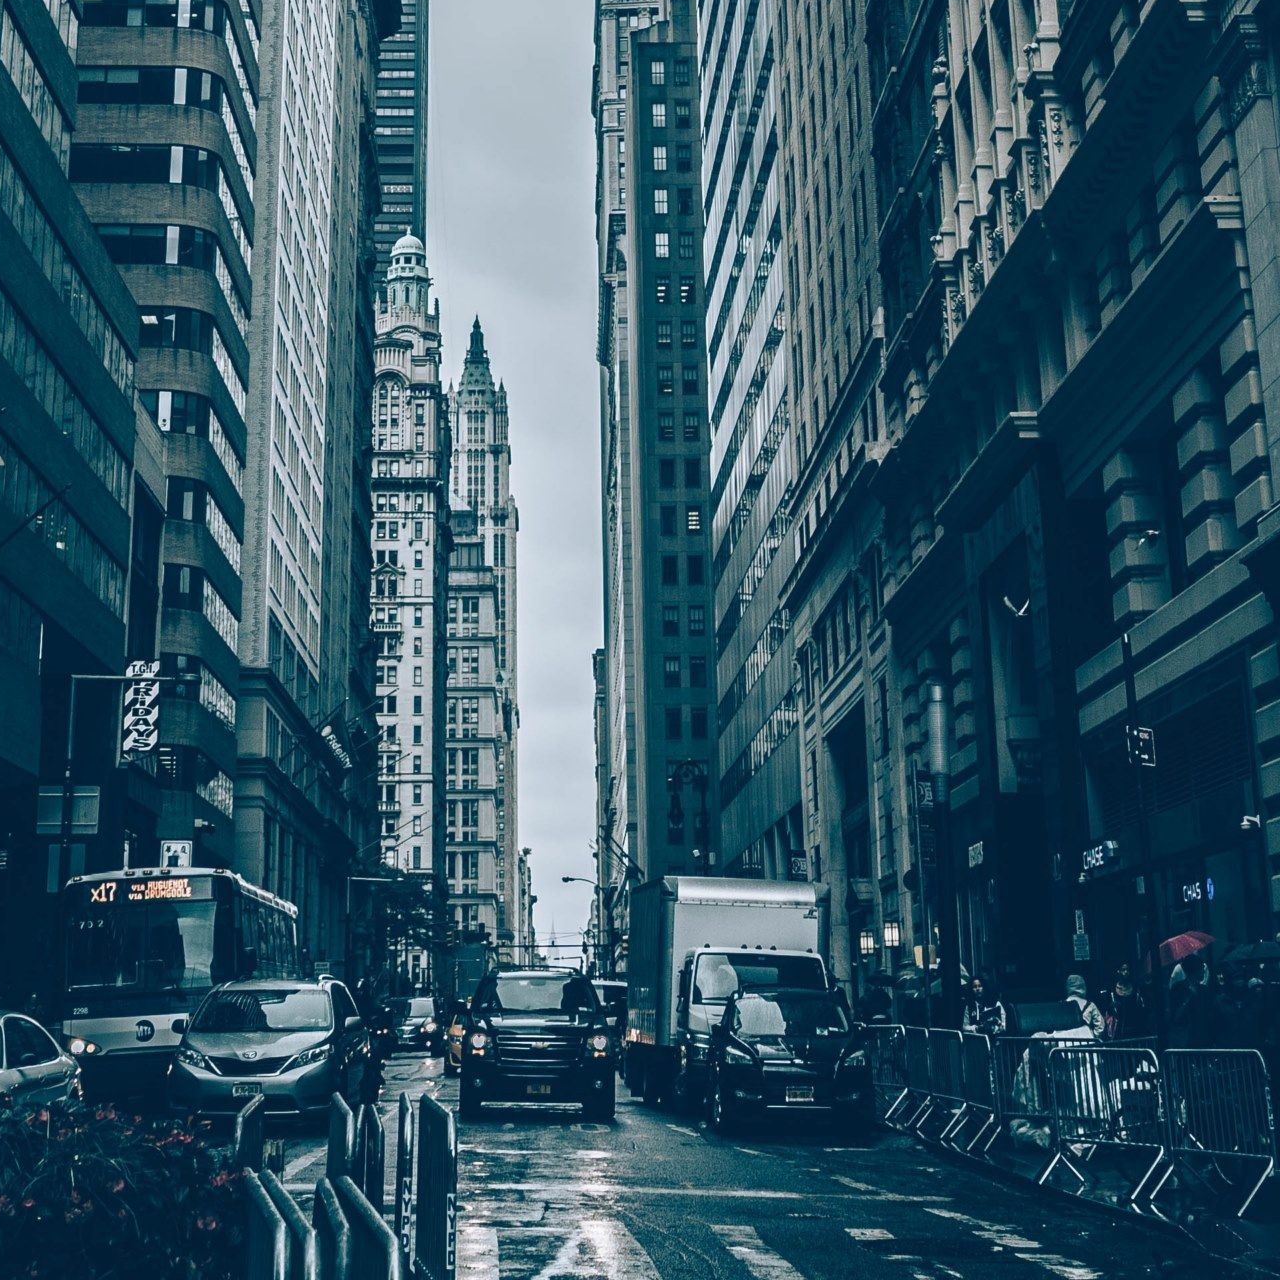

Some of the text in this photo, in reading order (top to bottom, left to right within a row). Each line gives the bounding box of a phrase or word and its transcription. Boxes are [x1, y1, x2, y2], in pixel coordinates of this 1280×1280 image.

[131, 664, 156, 674] T.G.I.
[131, 682, 154, 749] RIDAYS
[326, 733, 353, 768] Fidelity
[1082, 845, 1104, 870] CHASE
[144, 887, 192, 900] DRUMGOOLE
[147, 878, 189, 891] HUGUENOT
[1182, 881, 1202, 903] CHAS
[401, 1179, 411, 1249] NYPD
[447, 1196, 456, 1266] NYPD
